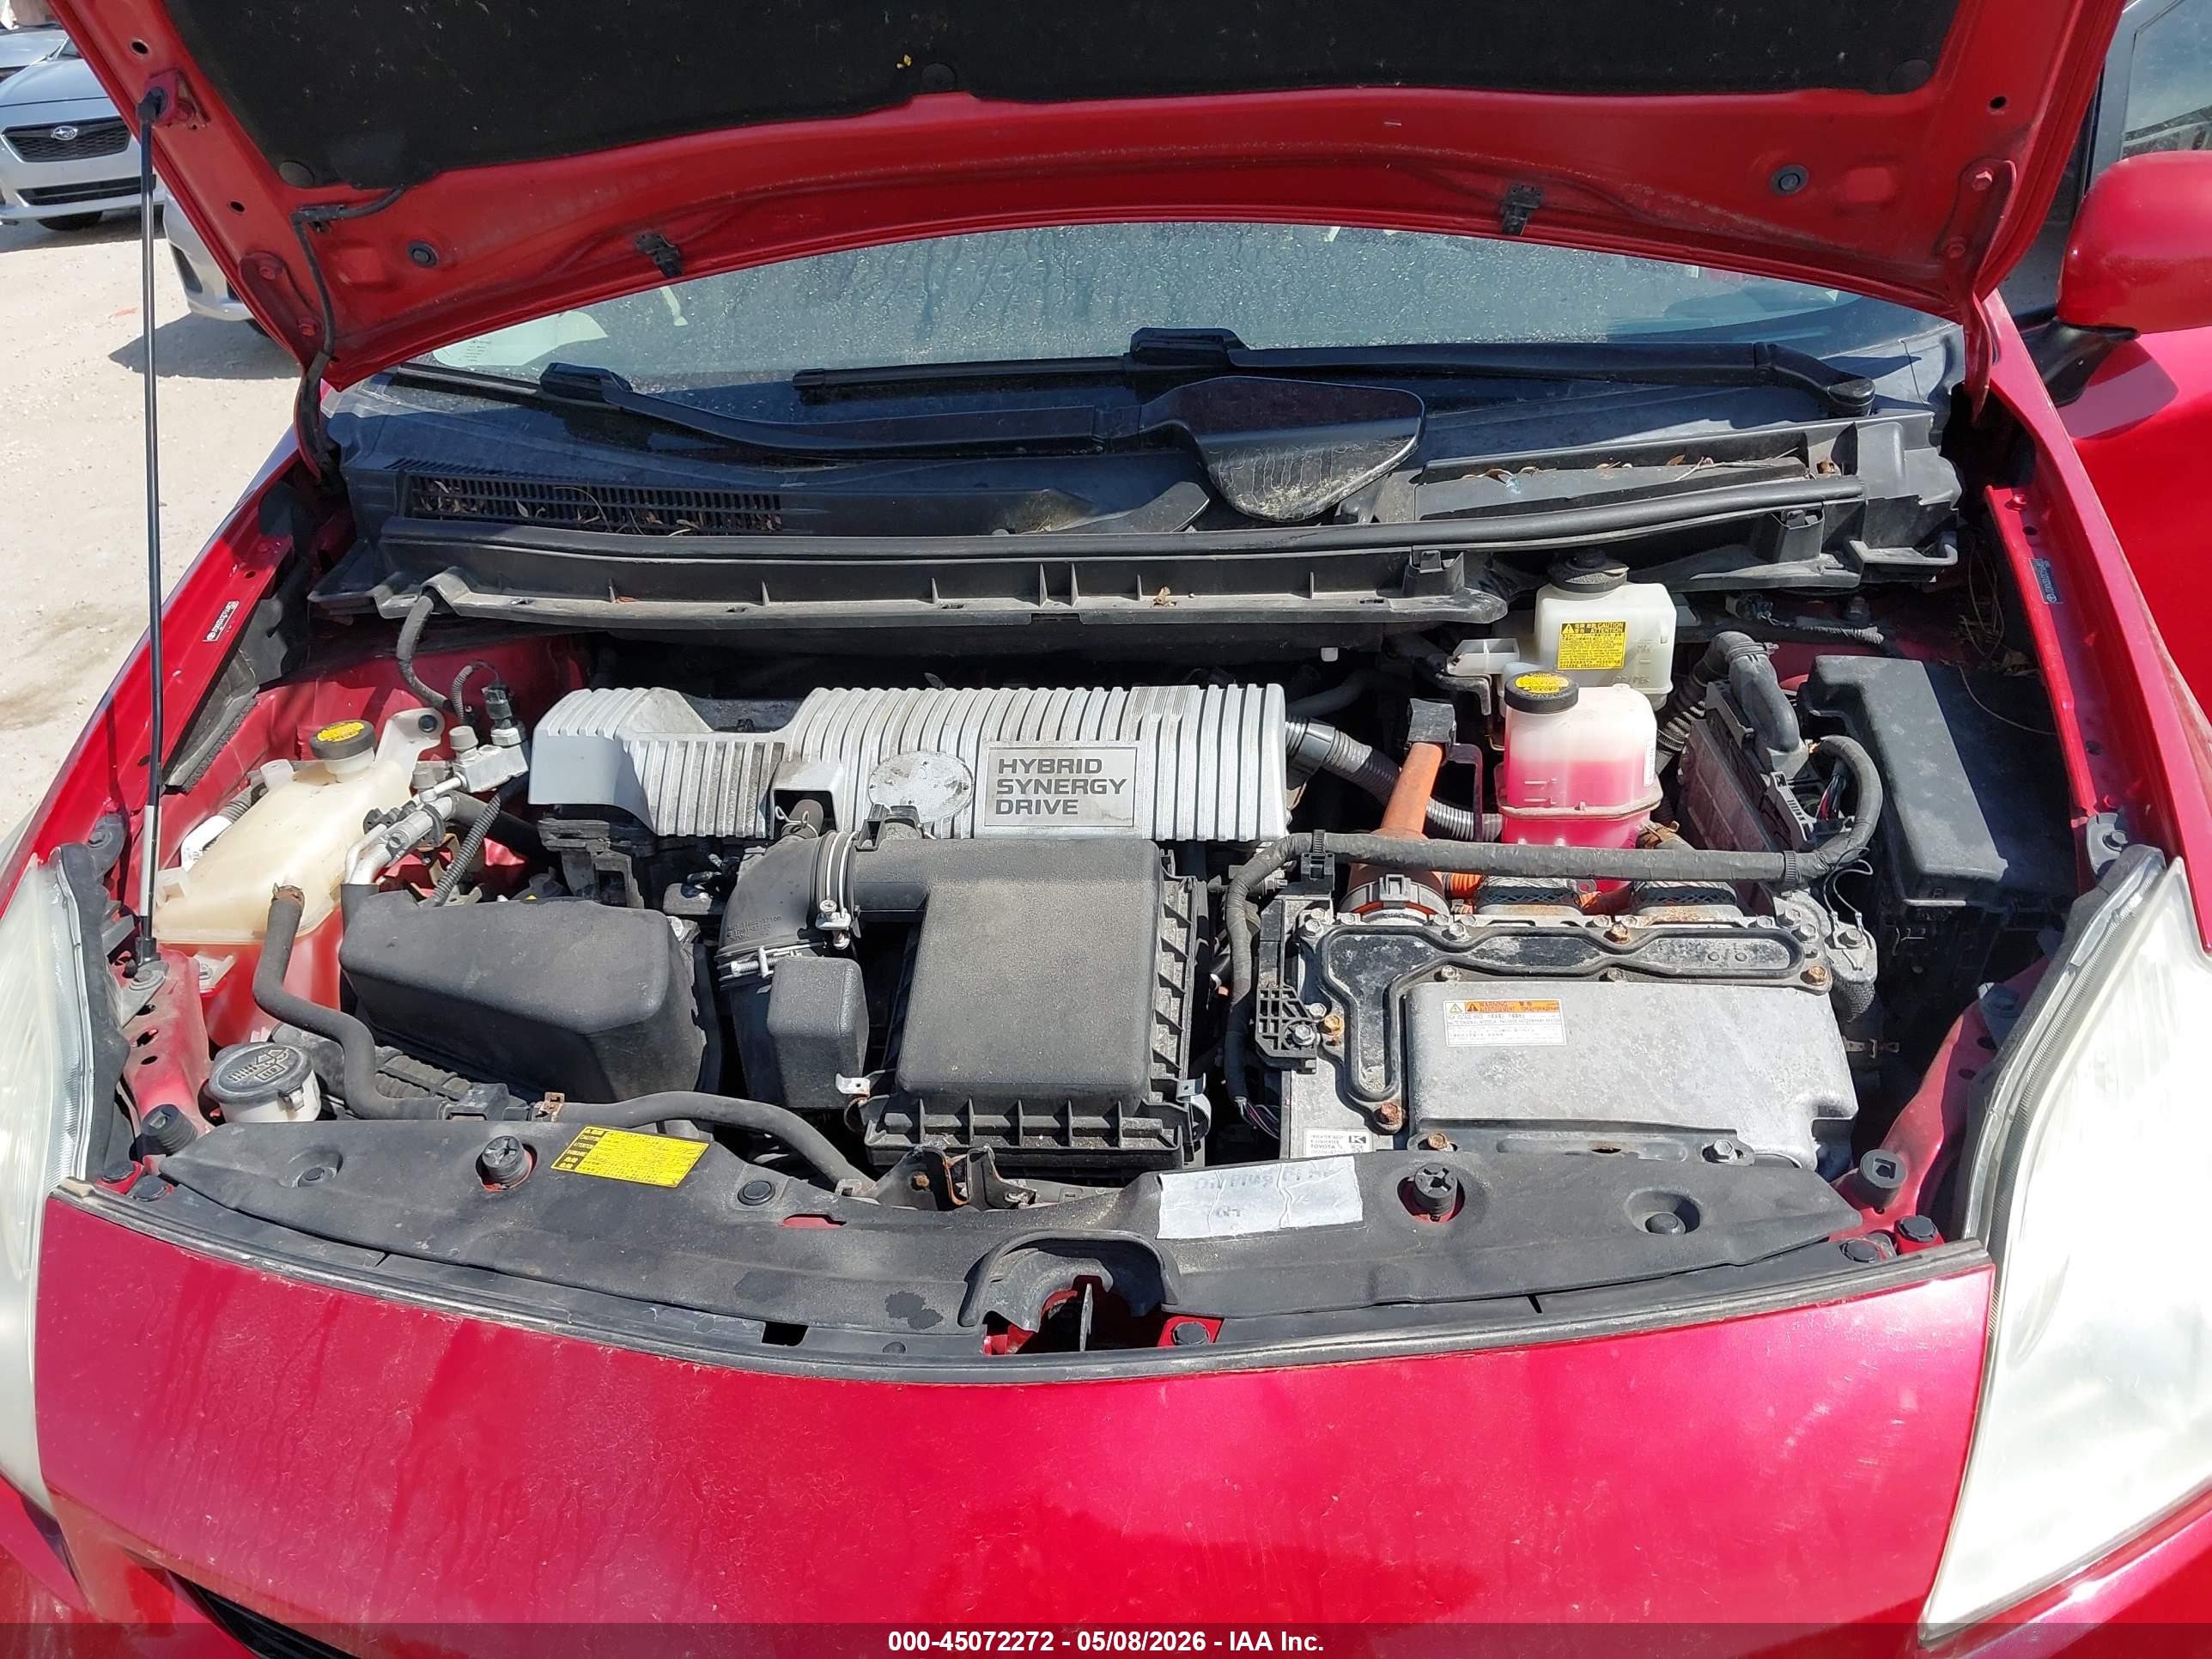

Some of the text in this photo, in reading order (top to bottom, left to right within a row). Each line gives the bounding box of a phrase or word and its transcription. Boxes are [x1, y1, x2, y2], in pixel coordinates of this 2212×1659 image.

[998, 758, 1103, 775] HYBRID
[996, 778, 1127, 795] SYNERGY
[995, 799, 1079, 815] DRIVE
